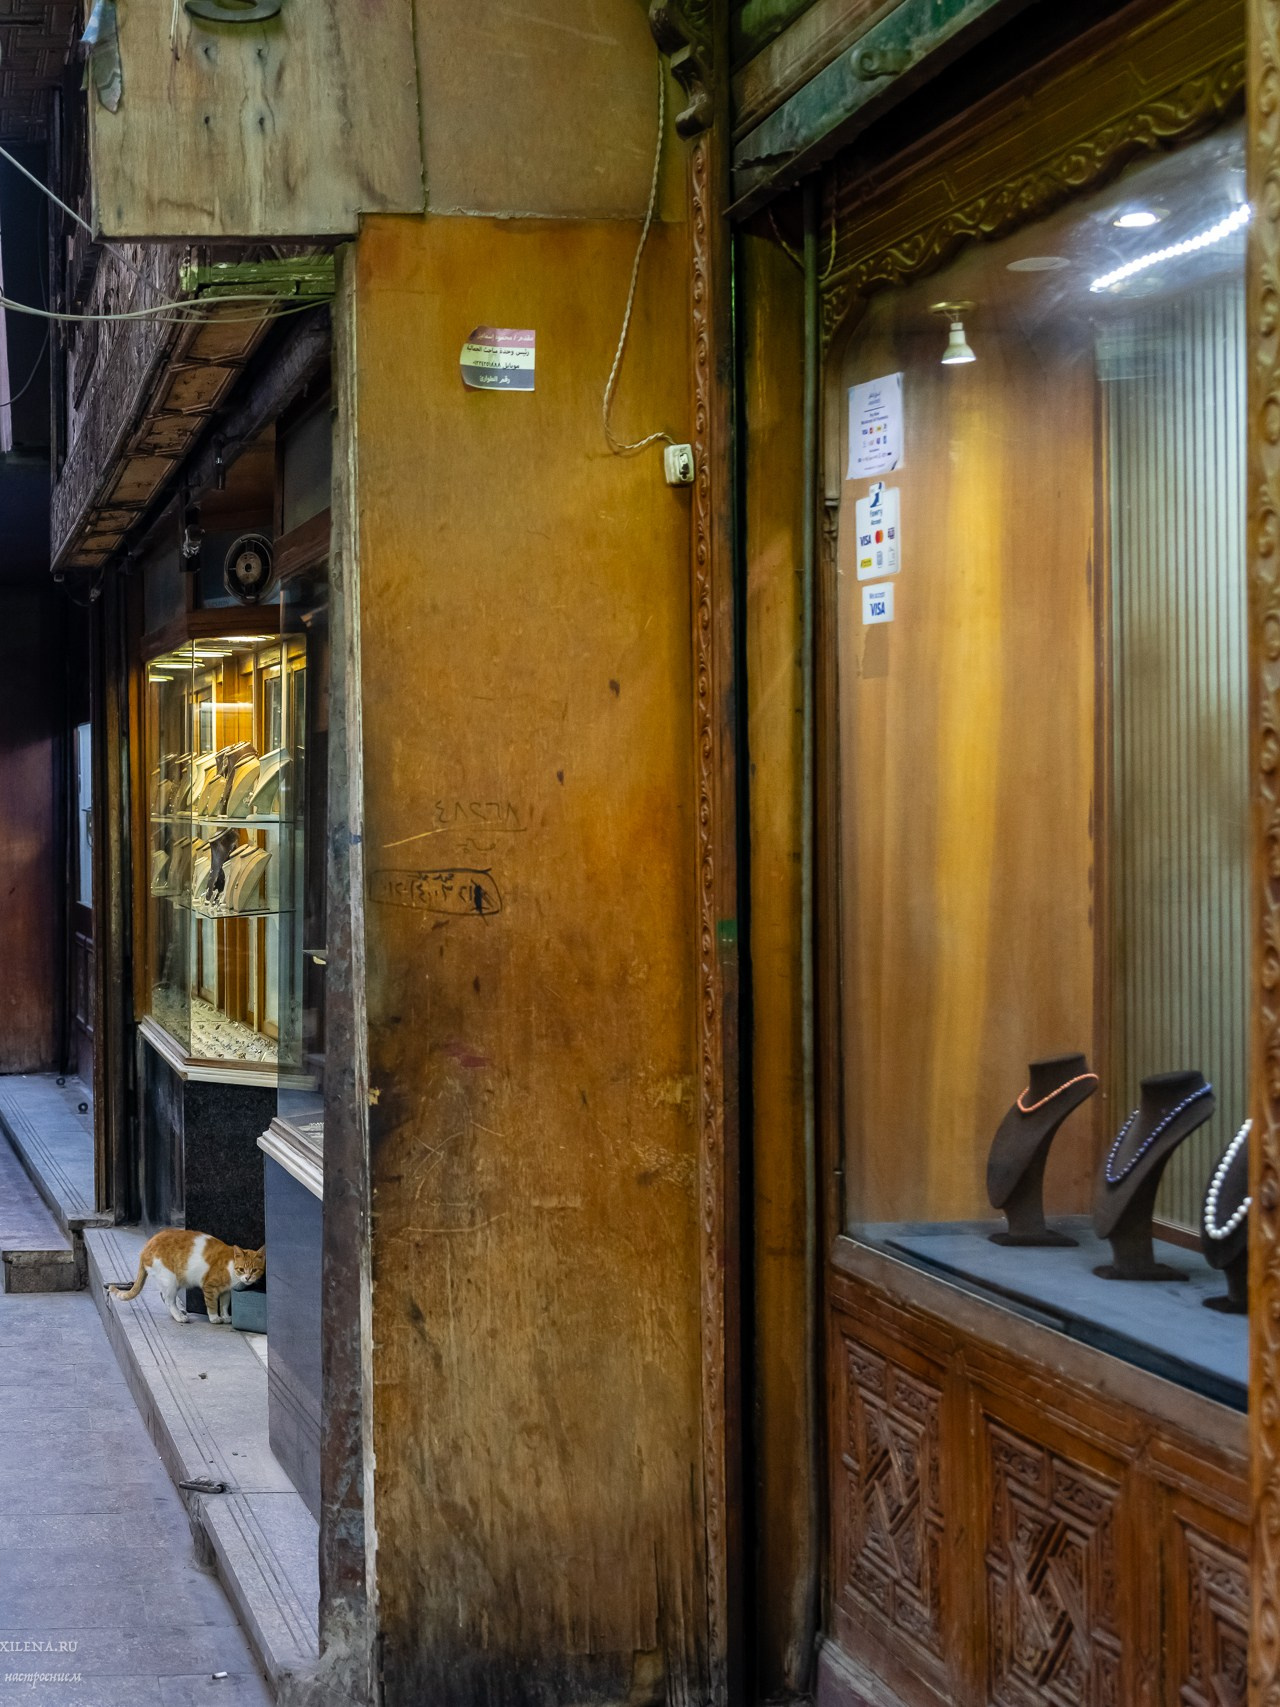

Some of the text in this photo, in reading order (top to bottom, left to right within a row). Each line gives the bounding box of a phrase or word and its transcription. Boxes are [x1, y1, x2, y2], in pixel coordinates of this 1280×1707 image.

[499, 375, 511, 384] رقم
[859, 534, 872, 547] VISA
[869, 601, 886, 617] VISA
